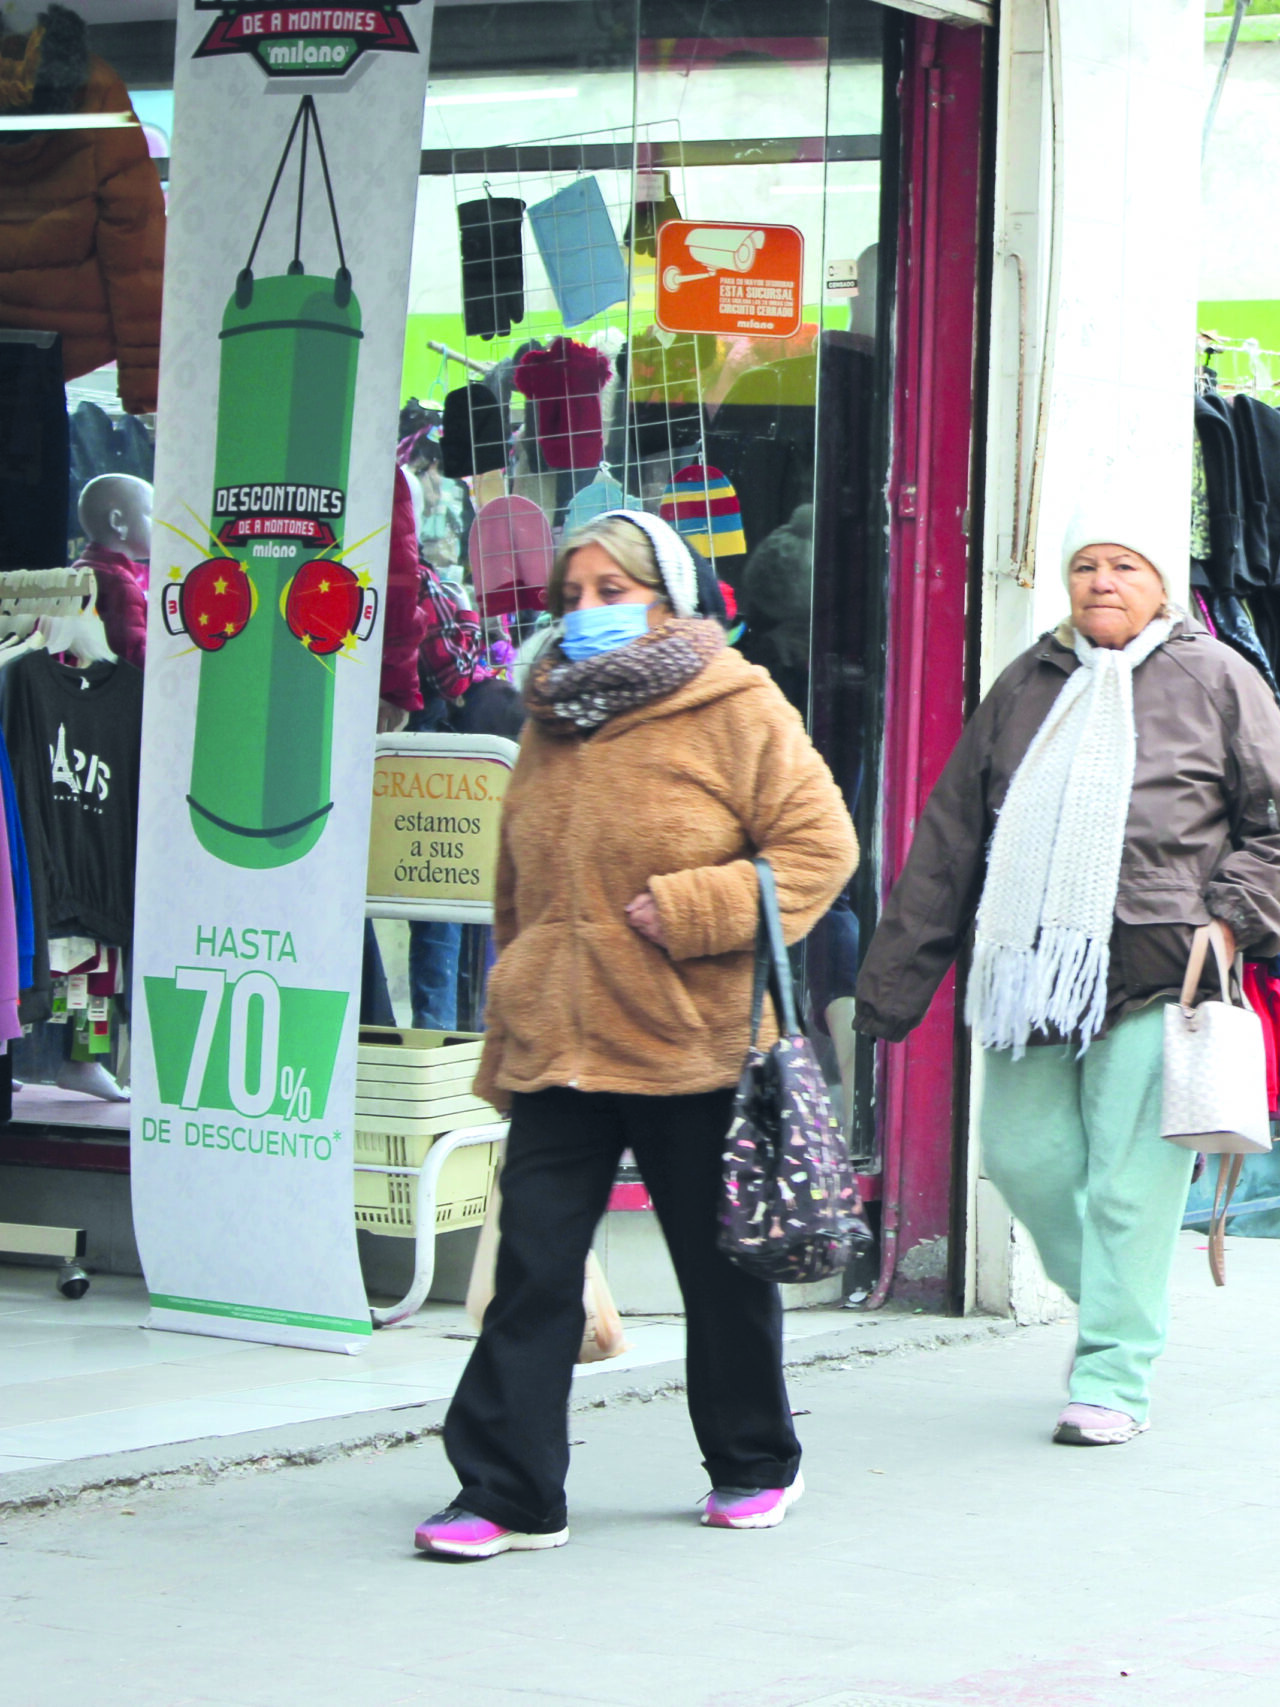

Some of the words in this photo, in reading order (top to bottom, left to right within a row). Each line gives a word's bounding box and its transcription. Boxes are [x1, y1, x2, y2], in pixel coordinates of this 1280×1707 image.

[242, 14, 264, 34] DE
[271, 13, 282, 31] A
[288, 11, 376, 31] MONTONES
[267, 40, 349, 64] milano
[720, 285, 744, 298] ESTA
[746, 287, 793, 301] SUCURSAL
[719, 303, 755, 315] CIRCUITO
[757, 305, 793, 317] CERRADO
[737, 319, 774, 330] milano
[216, 486, 343, 514] DESCONTONES
[238, 520, 253, 534] DE
[254, 520, 261, 534] A
[263, 519, 314, 536] MONTONES
[252, 540, 297, 558] milano
[394, 812, 481, 835] estamos
[410, 840, 422, 857] a
[429, 841, 464, 859] sus
[394, 858, 480, 885] órdenes
[196, 925, 298, 963] HASTA
[175, 965, 311, 1123] 70%
[142, 1117, 171, 1144] DE
